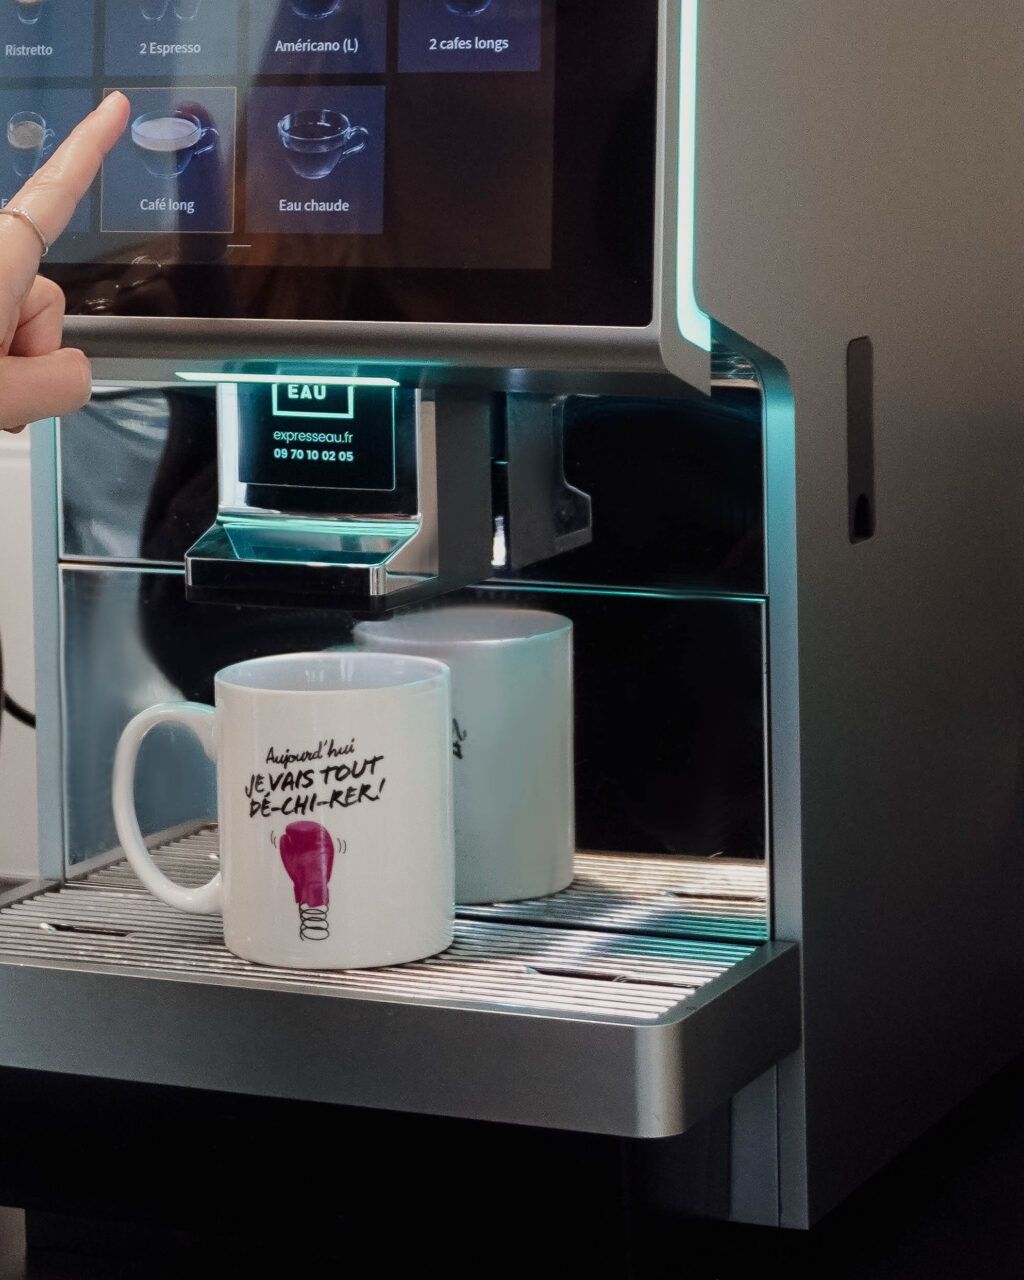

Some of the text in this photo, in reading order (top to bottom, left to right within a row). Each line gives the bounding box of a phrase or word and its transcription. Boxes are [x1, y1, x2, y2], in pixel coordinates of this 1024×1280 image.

[5, 44, 53, 56] Ristretto
[139, 42, 201, 56] 2 Espresso
[275, 37, 359, 54] Américano (L)
[429, 36, 509, 53] 2 cafes longs
[140, 197, 195, 214] Café long
[279, 199, 350, 211] Eau chaude
[287, 384, 327, 400] EAU
[273, 430, 354, 444] expresseau.fr
[274, 448, 354, 462] 09 70 10 02 05
[265, 737, 355, 769] Aujourd'hui
[245, 755, 384, 799] JE VAIS TOUT
